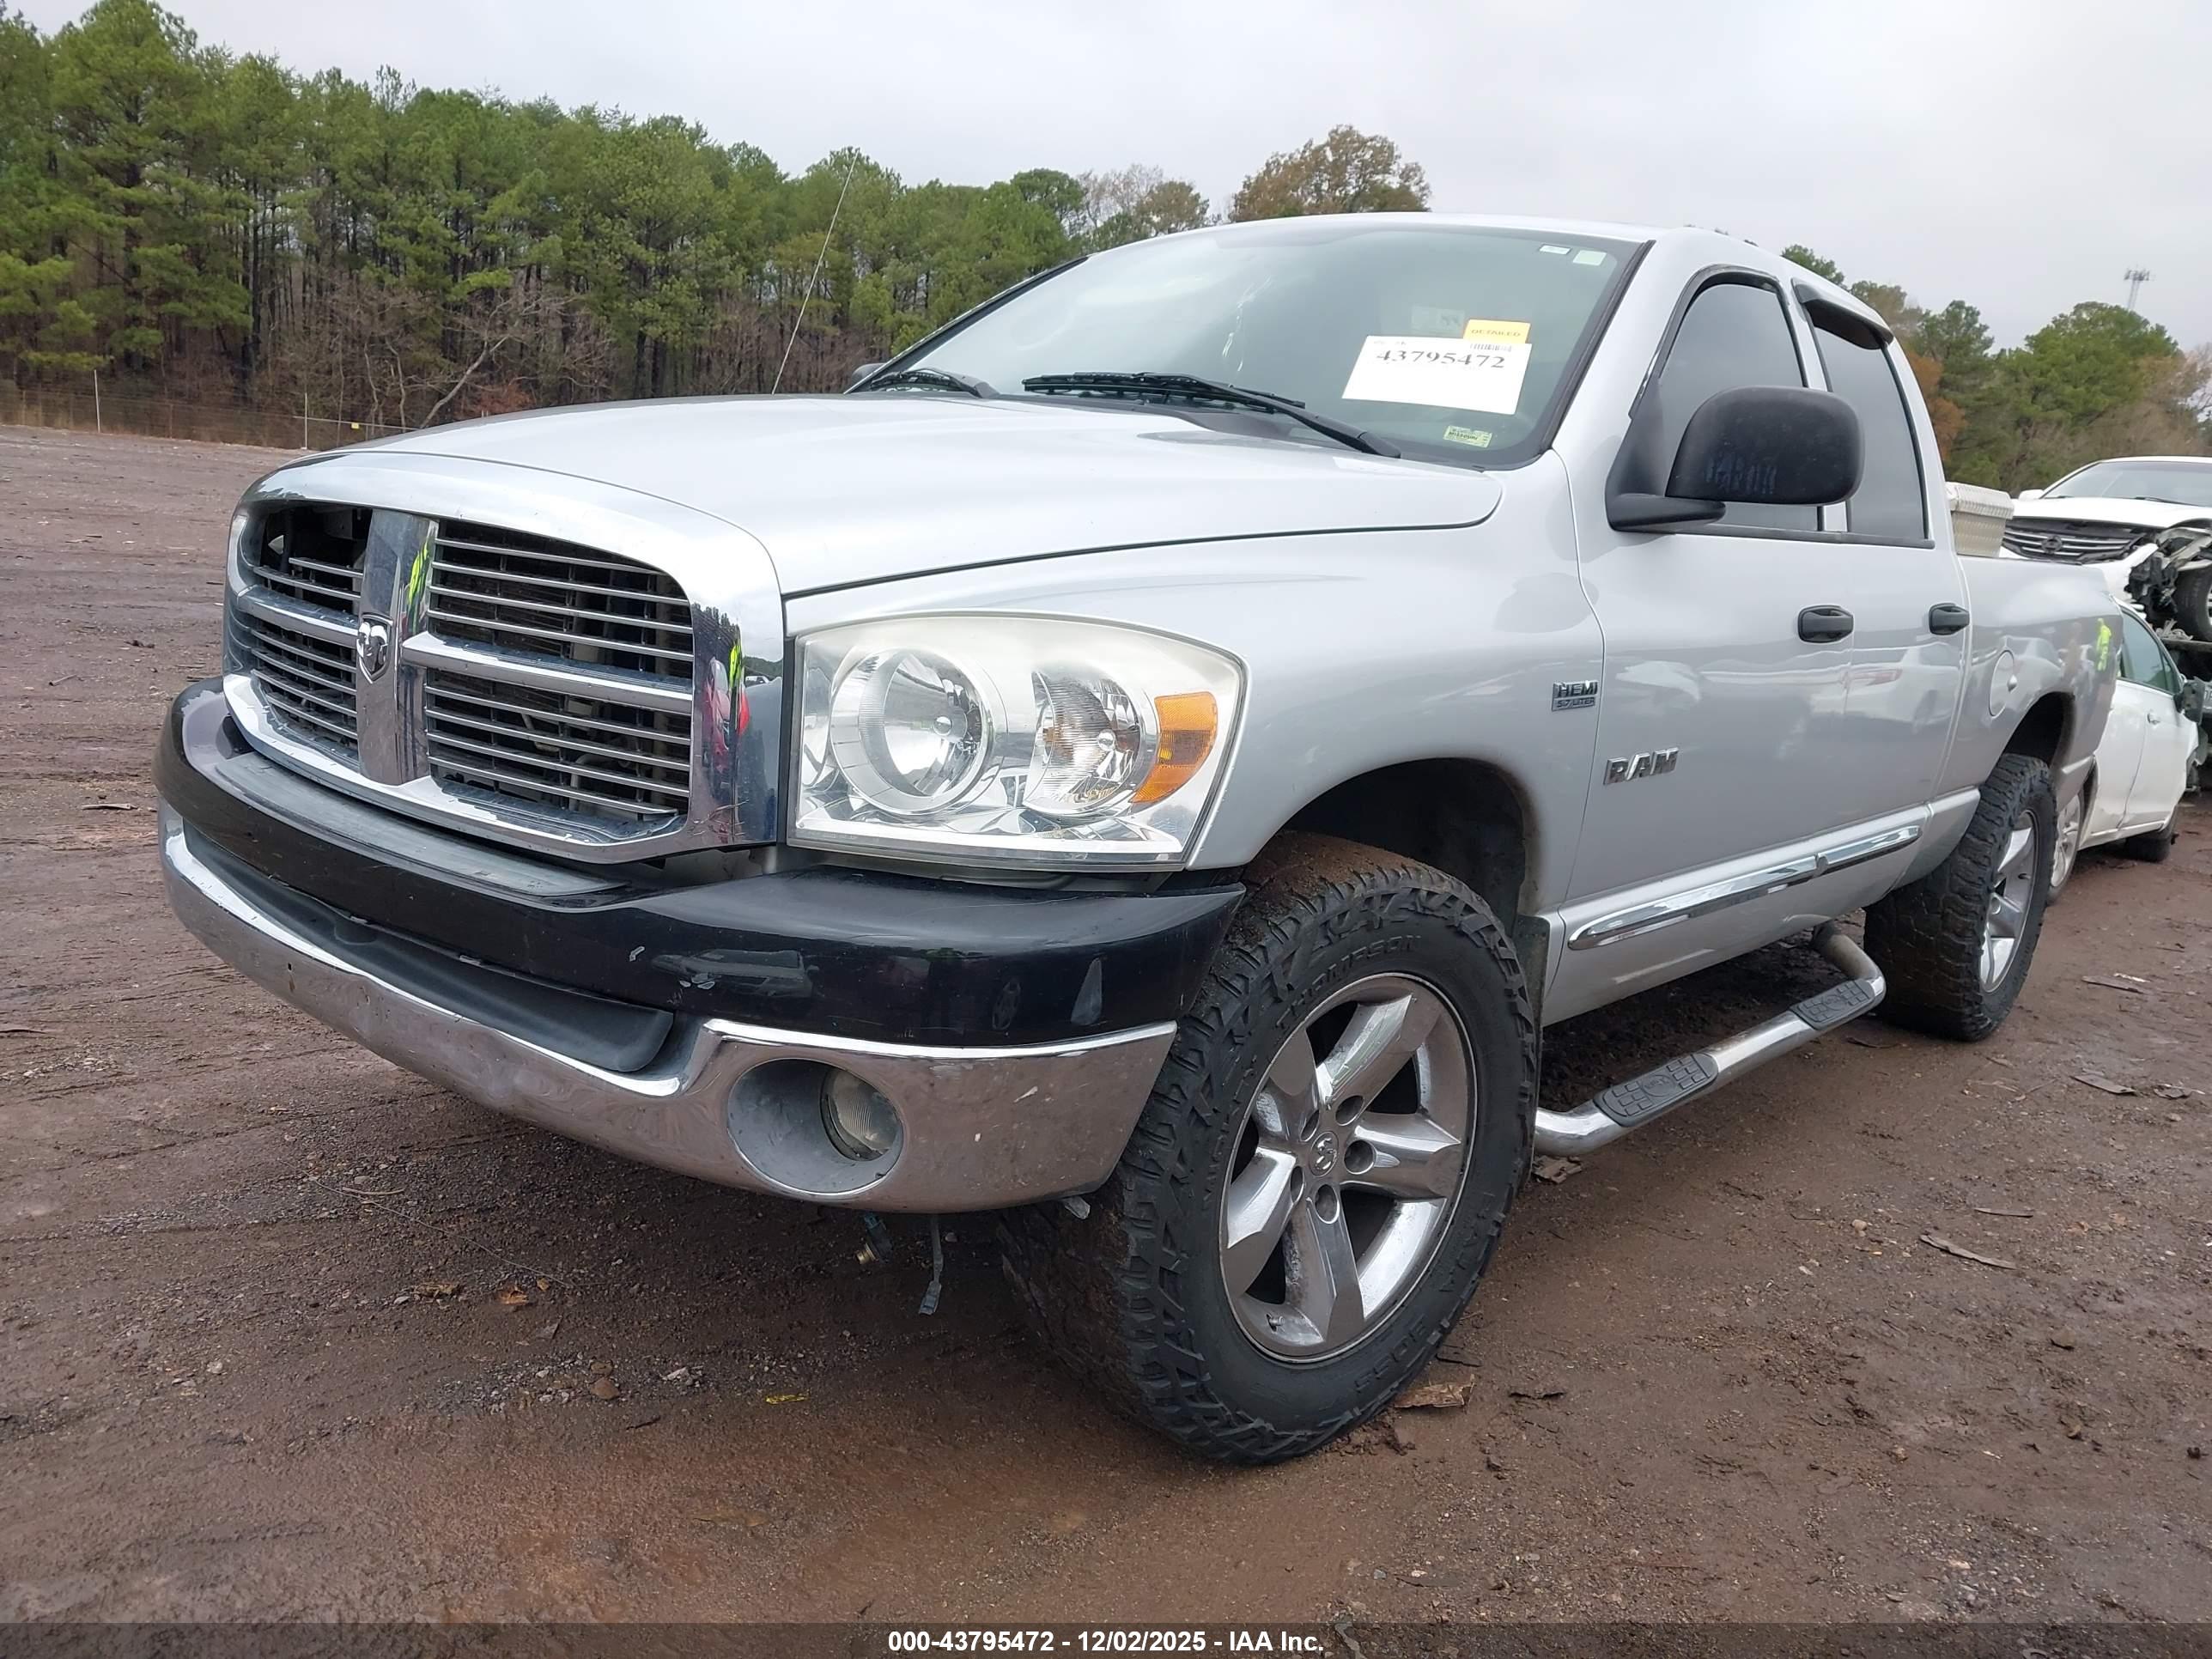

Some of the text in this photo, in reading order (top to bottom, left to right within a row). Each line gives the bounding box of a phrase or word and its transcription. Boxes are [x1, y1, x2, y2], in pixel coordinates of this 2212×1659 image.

[1376, 349, 1505, 369] 43795472
[1555, 681, 1598, 697] HEMI
[1604, 747, 1679, 785] RAM
